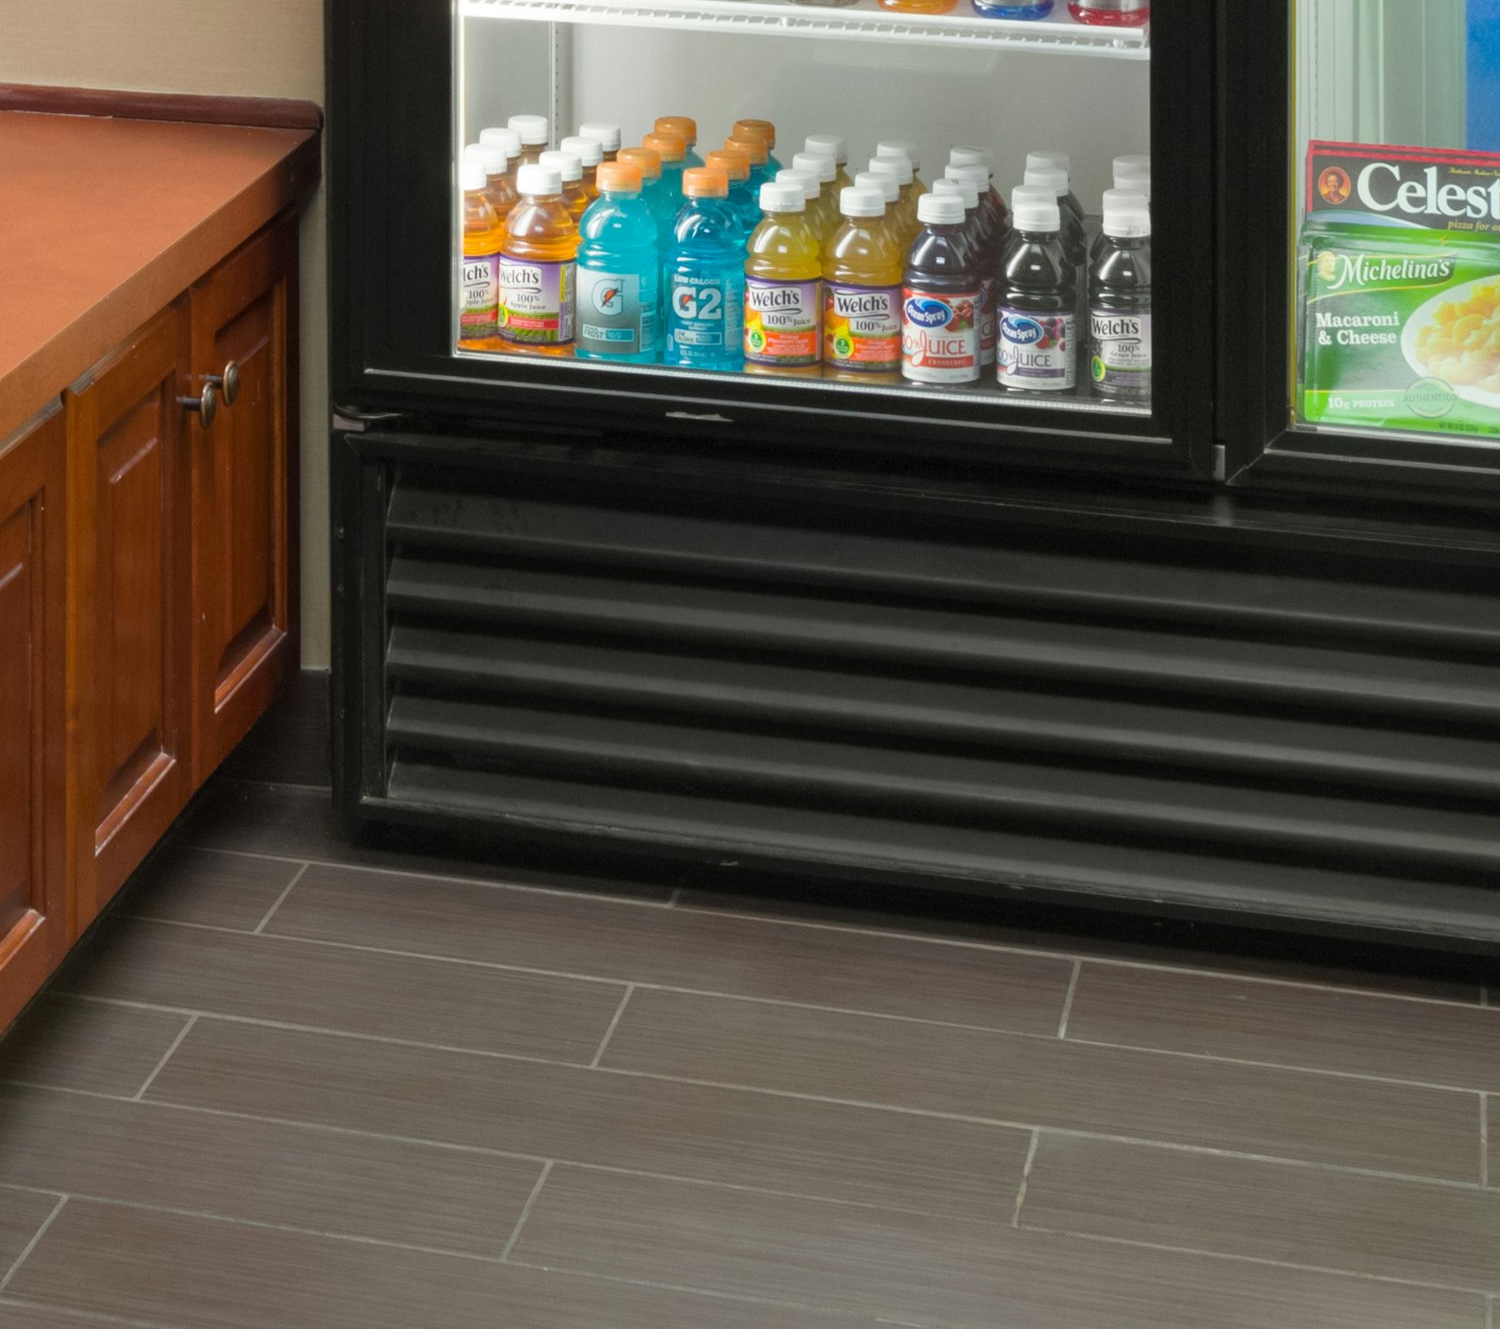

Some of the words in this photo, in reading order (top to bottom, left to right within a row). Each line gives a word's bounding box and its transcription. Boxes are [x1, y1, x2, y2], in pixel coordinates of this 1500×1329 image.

[1326, 254, 1450, 290] Michelina's
[750, 288, 801, 307] Welch's
[837, 295, 888, 313] Welch's
[1092, 317, 1139, 335] Welch's
[1315, 312, 1400, 328] Macaroni
[1318, 331, 1332, 345] &
[1336, 329, 1397, 345] Cheese
